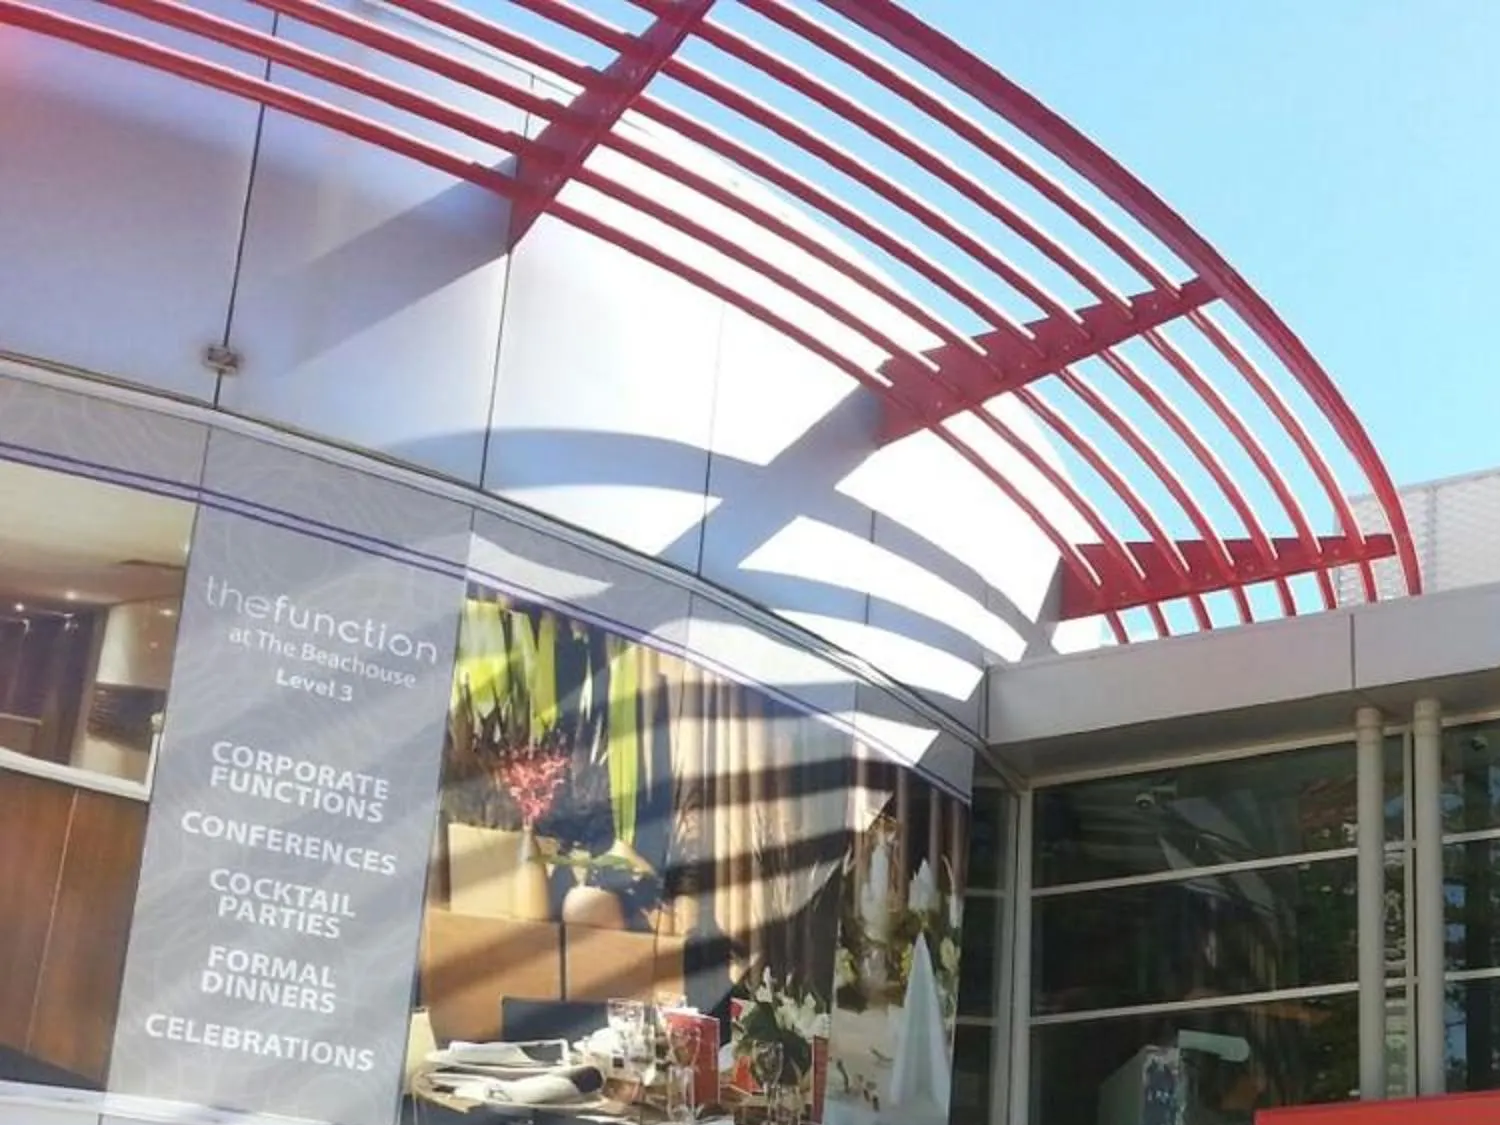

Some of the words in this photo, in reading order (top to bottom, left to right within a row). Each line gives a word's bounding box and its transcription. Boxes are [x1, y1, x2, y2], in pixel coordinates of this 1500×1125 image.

[206, 575, 437, 664] thefunction
[228, 627, 252, 646] at
[256, 629, 297, 658] The
[301, 643, 417, 688] Beachouse
[276, 668, 336, 698] Level
[339, 684, 354, 701] 3
[210, 765, 384, 823] FUNCTIONS
[212, 741, 390, 800] CORPORATE
[181, 811, 397, 876] CONFERENCES
[210, 868, 356, 917] COCKTAIL
[218, 895, 341, 939] PARTIES
[201, 970, 337, 1013] DINNERS
[207, 945, 337, 989] FORMAL
[145, 1014, 374, 1072] CELEBRATIONS
